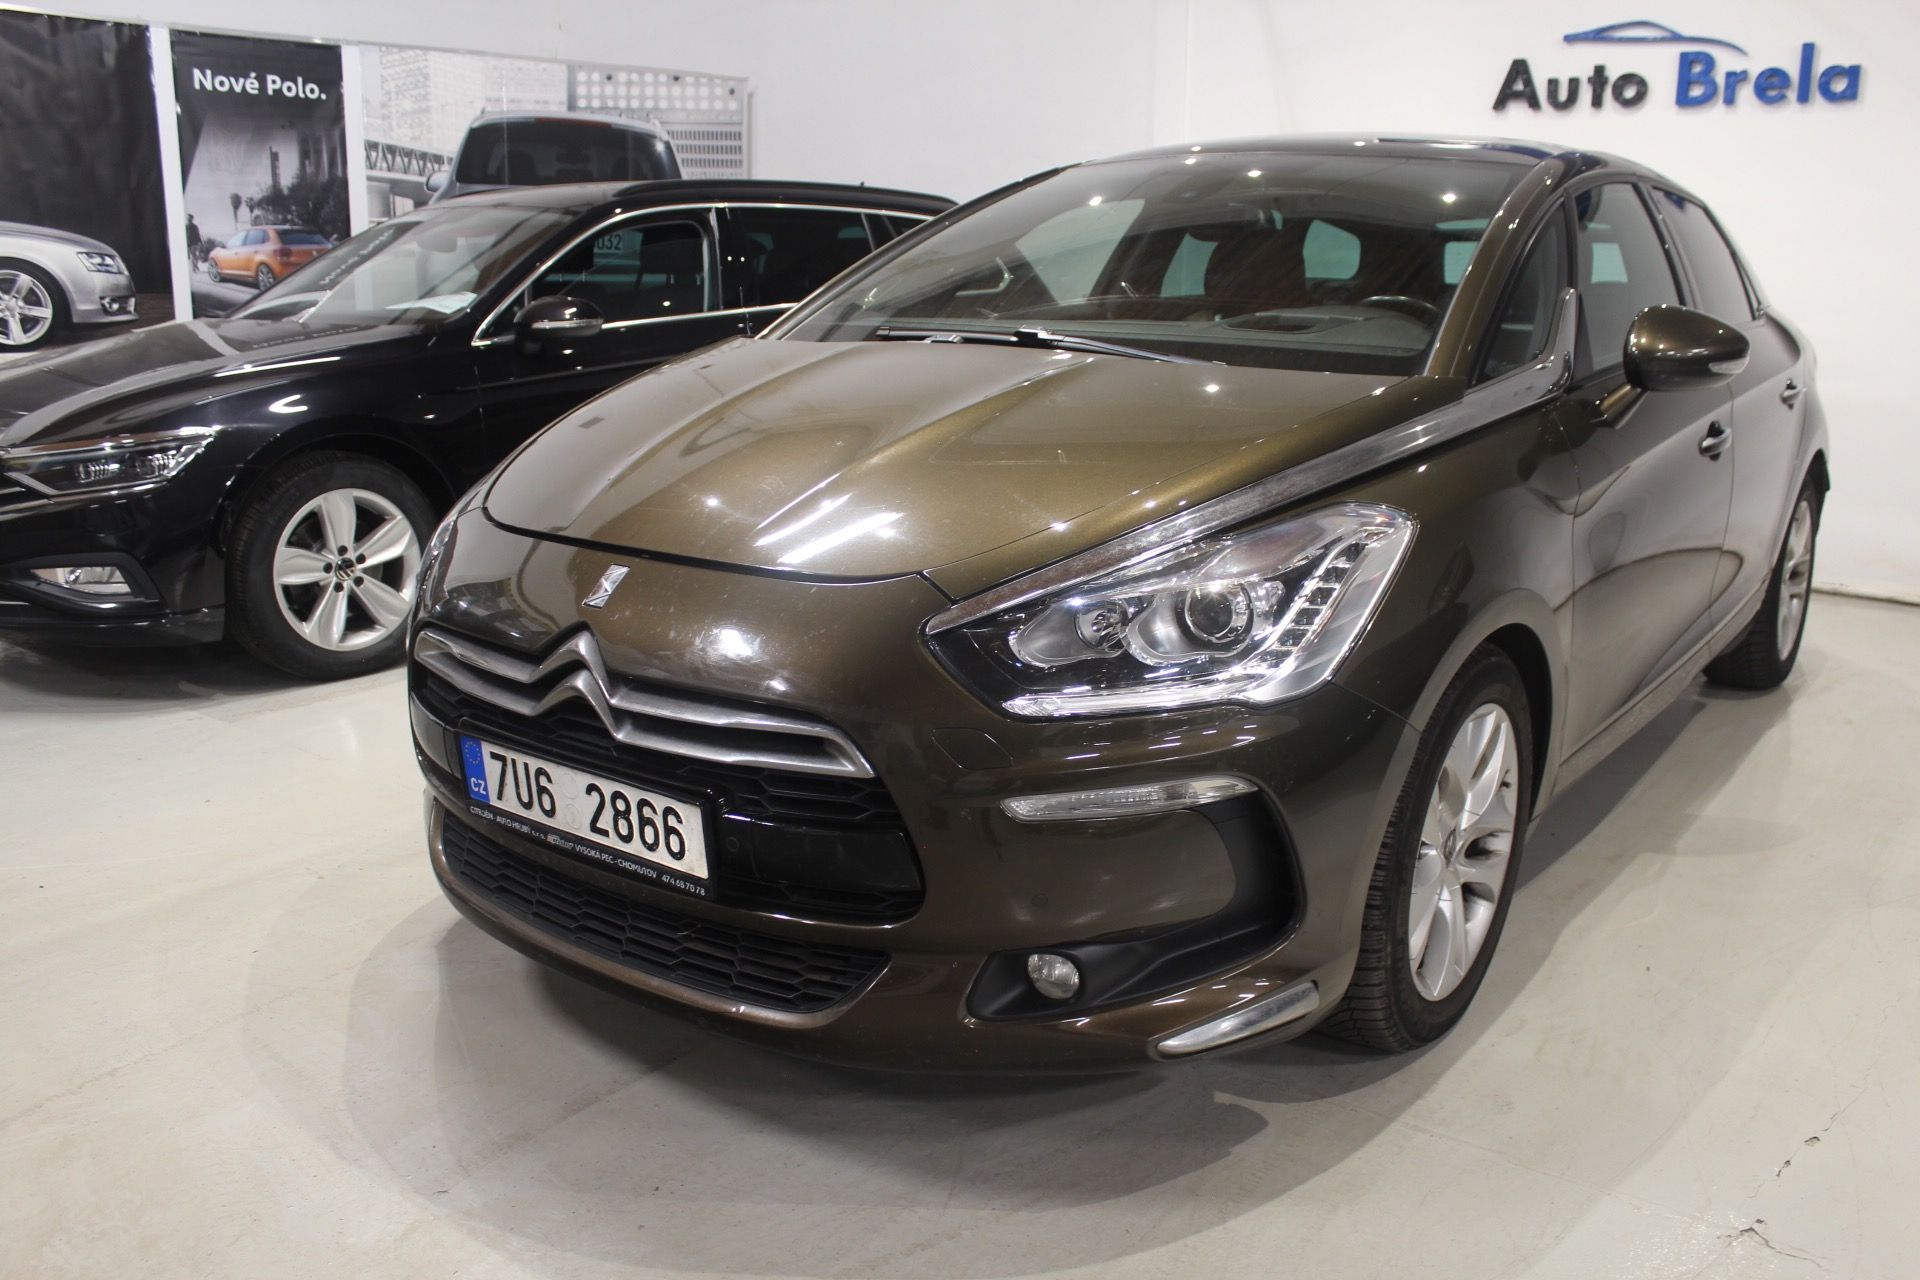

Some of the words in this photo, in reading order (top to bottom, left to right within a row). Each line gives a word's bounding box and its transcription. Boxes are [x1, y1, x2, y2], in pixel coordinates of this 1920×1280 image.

[192, 66, 260, 96] Nové
[266, 73, 328, 102] Polo.
[1492, 58, 1649, 111] Auto
[1675, 42, 1862, 108] Brela
[470, 777, 487, 796] CZ
[489, 750, 557, 819] 7U6
[585, 782, 687, 861] 2866
